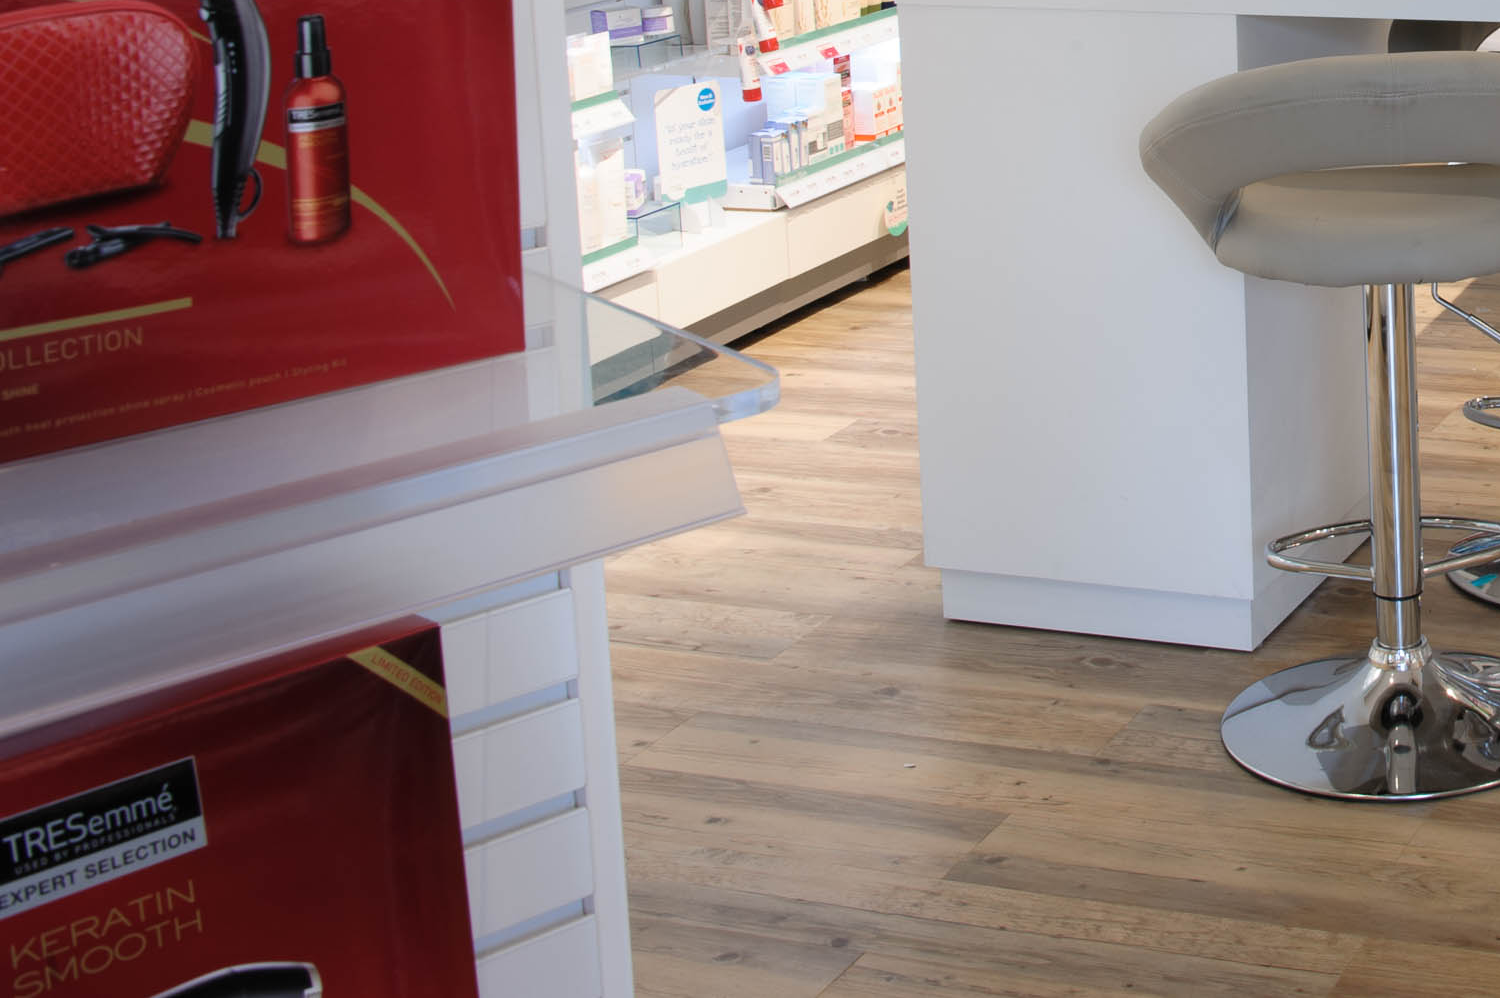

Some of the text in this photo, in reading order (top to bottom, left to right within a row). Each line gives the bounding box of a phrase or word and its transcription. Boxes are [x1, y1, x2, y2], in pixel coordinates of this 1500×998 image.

[370, 655, 443, 705] LIMITED EDITION
[2, 782, 174, 864] TRESemmé
[14, 812, 177, 876] USED BY PROFESSIONALS
[0, 827, 196, 911] EXPERT SELECTION
[10, 878, 196, 970] KERATIN
[14, 908, 203, 998] SMOOTH
